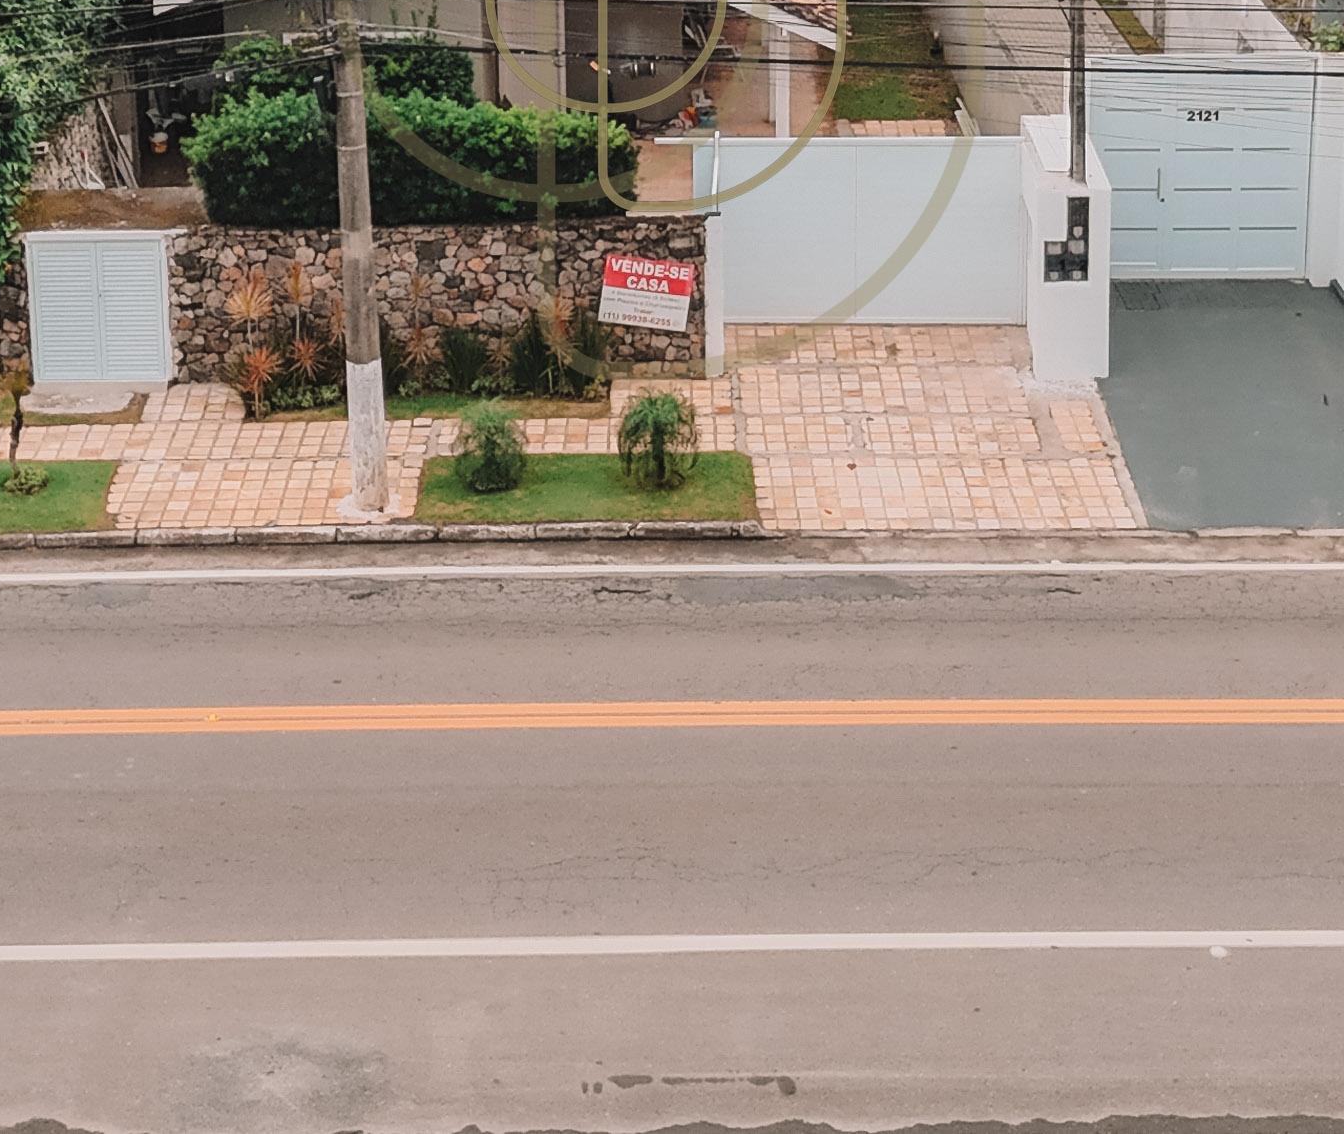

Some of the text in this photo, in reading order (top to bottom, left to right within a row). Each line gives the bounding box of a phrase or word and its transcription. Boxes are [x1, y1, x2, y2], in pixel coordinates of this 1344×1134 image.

[1187, 110, 1219, 122] 2121
[611, 258, 689, 280] VENDE-SE
[627, 276, 669, 293] CASA
[603, 312, 619, 320] (11)
